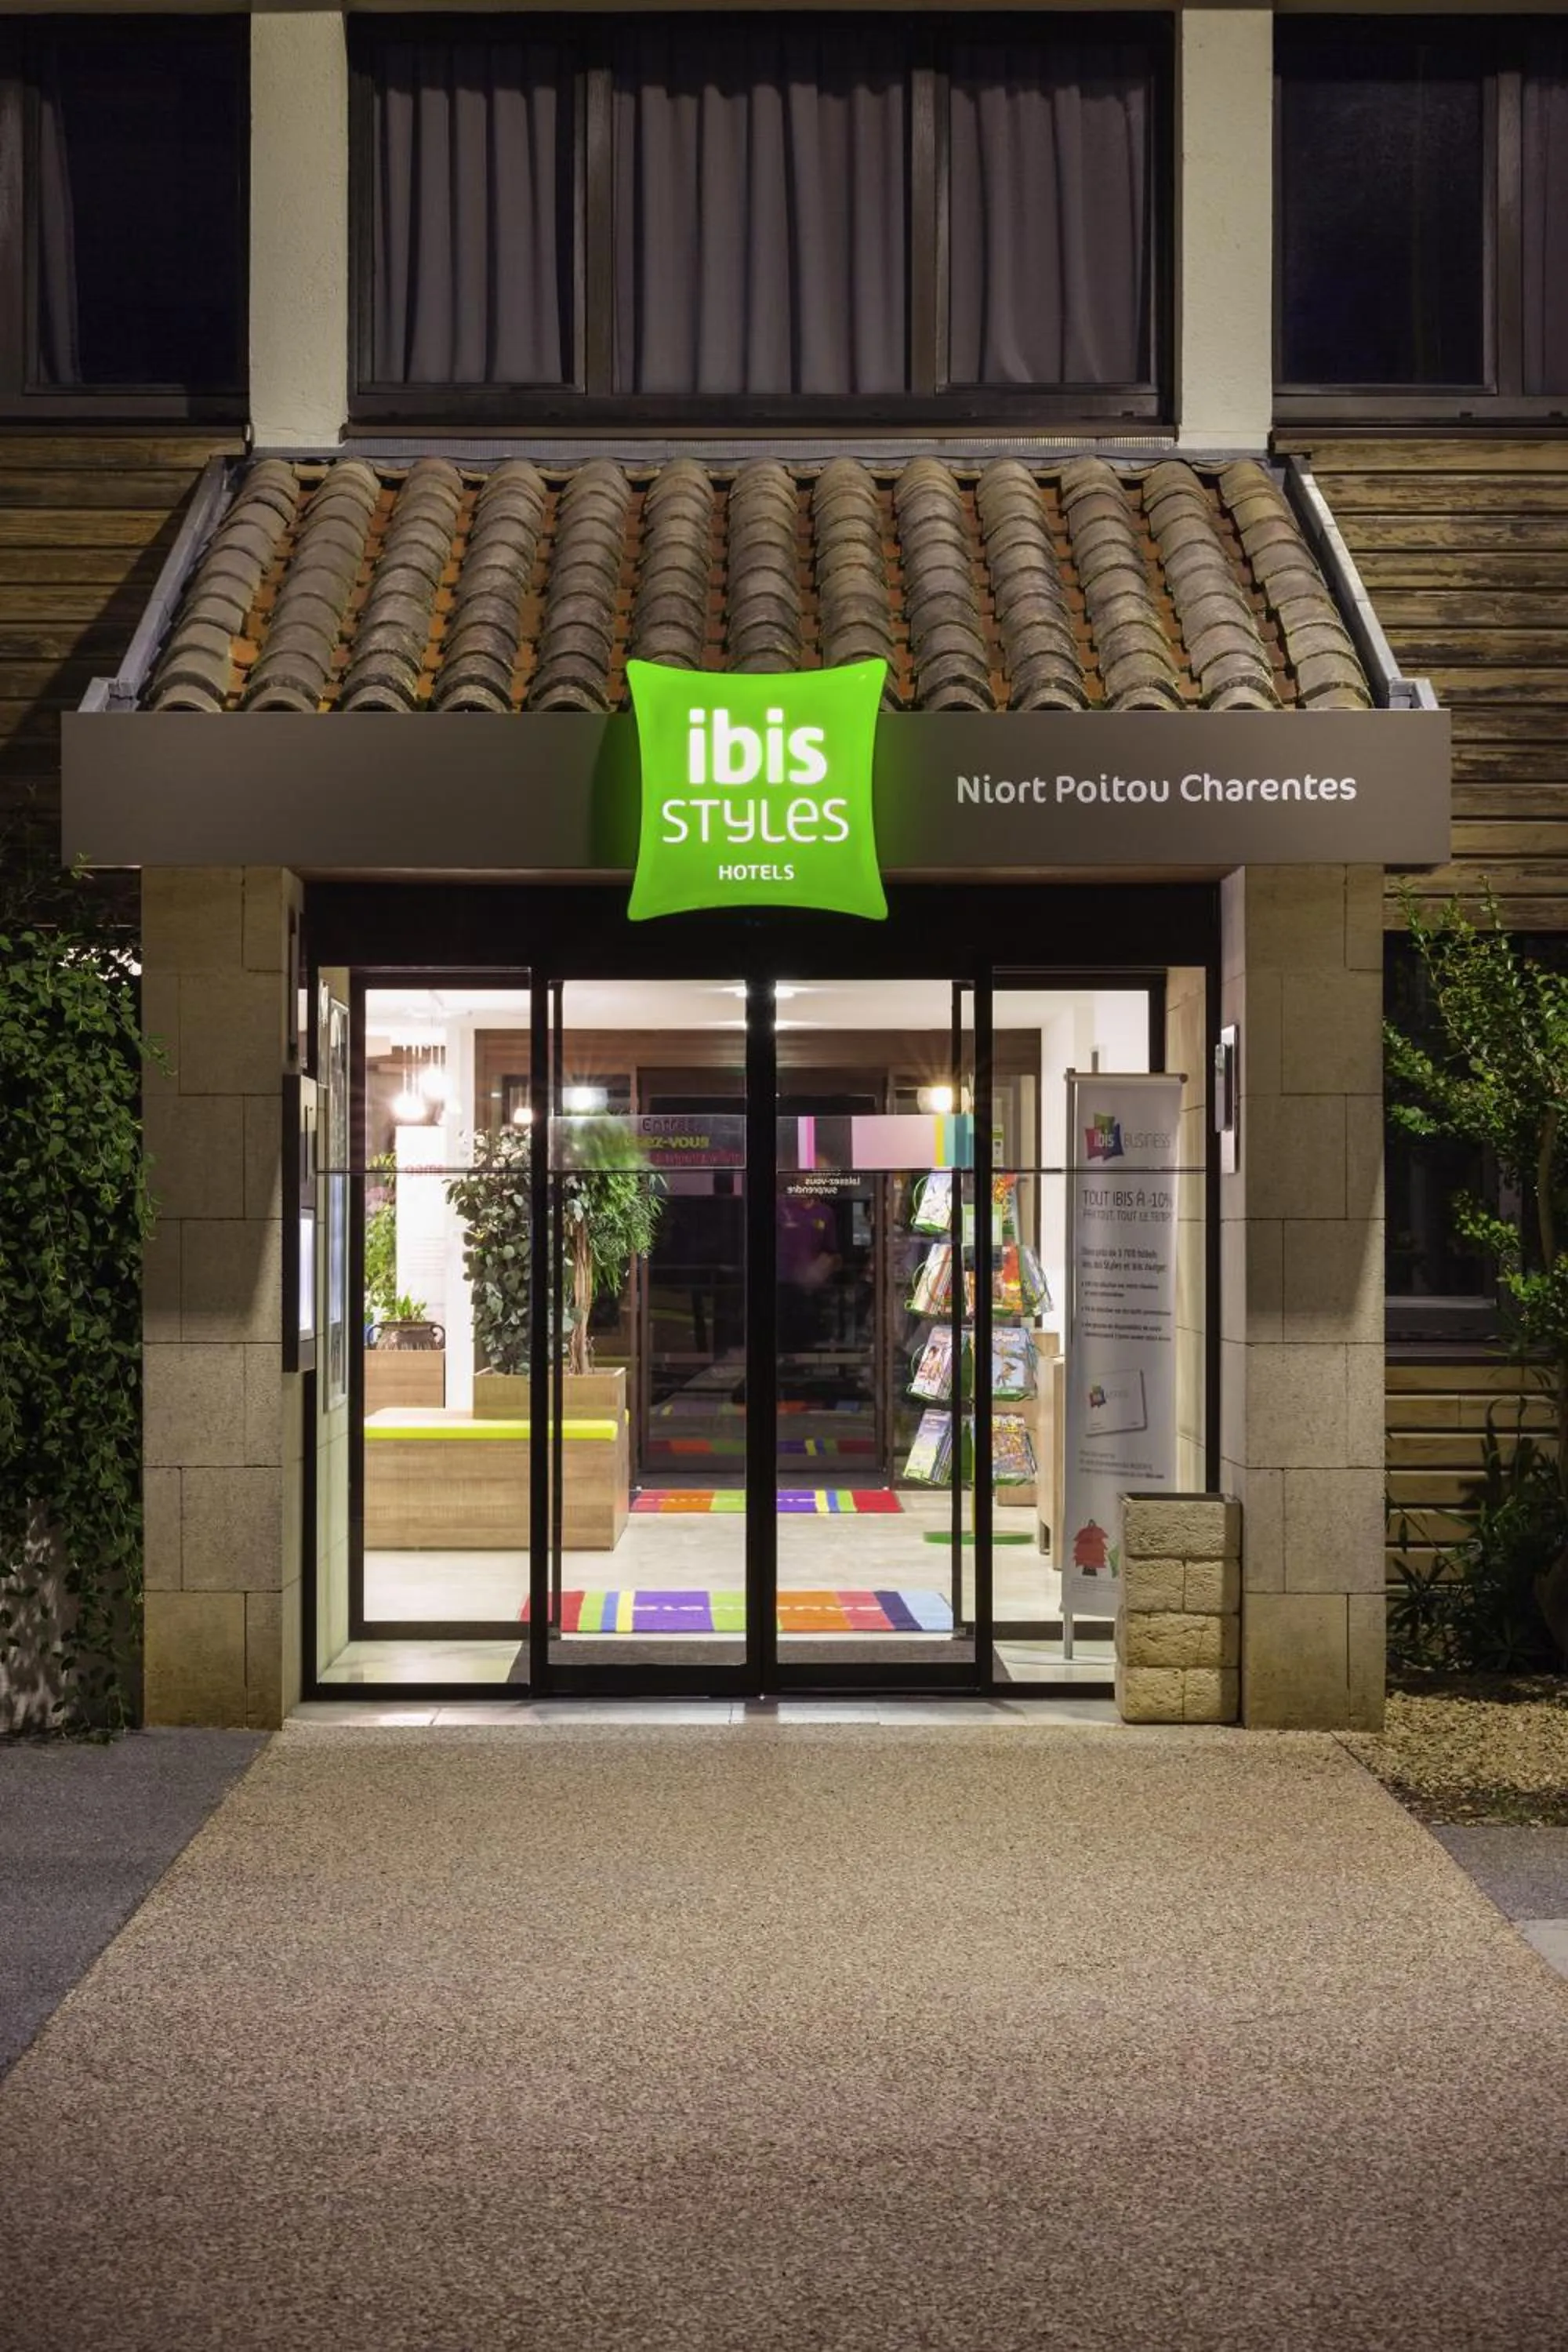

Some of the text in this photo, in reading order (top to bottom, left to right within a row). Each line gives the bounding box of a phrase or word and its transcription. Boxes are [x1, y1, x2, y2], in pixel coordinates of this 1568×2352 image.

[688, 708, 828, 785] ibis
[956, 773, 1358, 804] Niort Poitou Charentes
[718, 864, 794, 881] HOTELS
[1112, 1190, 1134, 1207] IBIS
